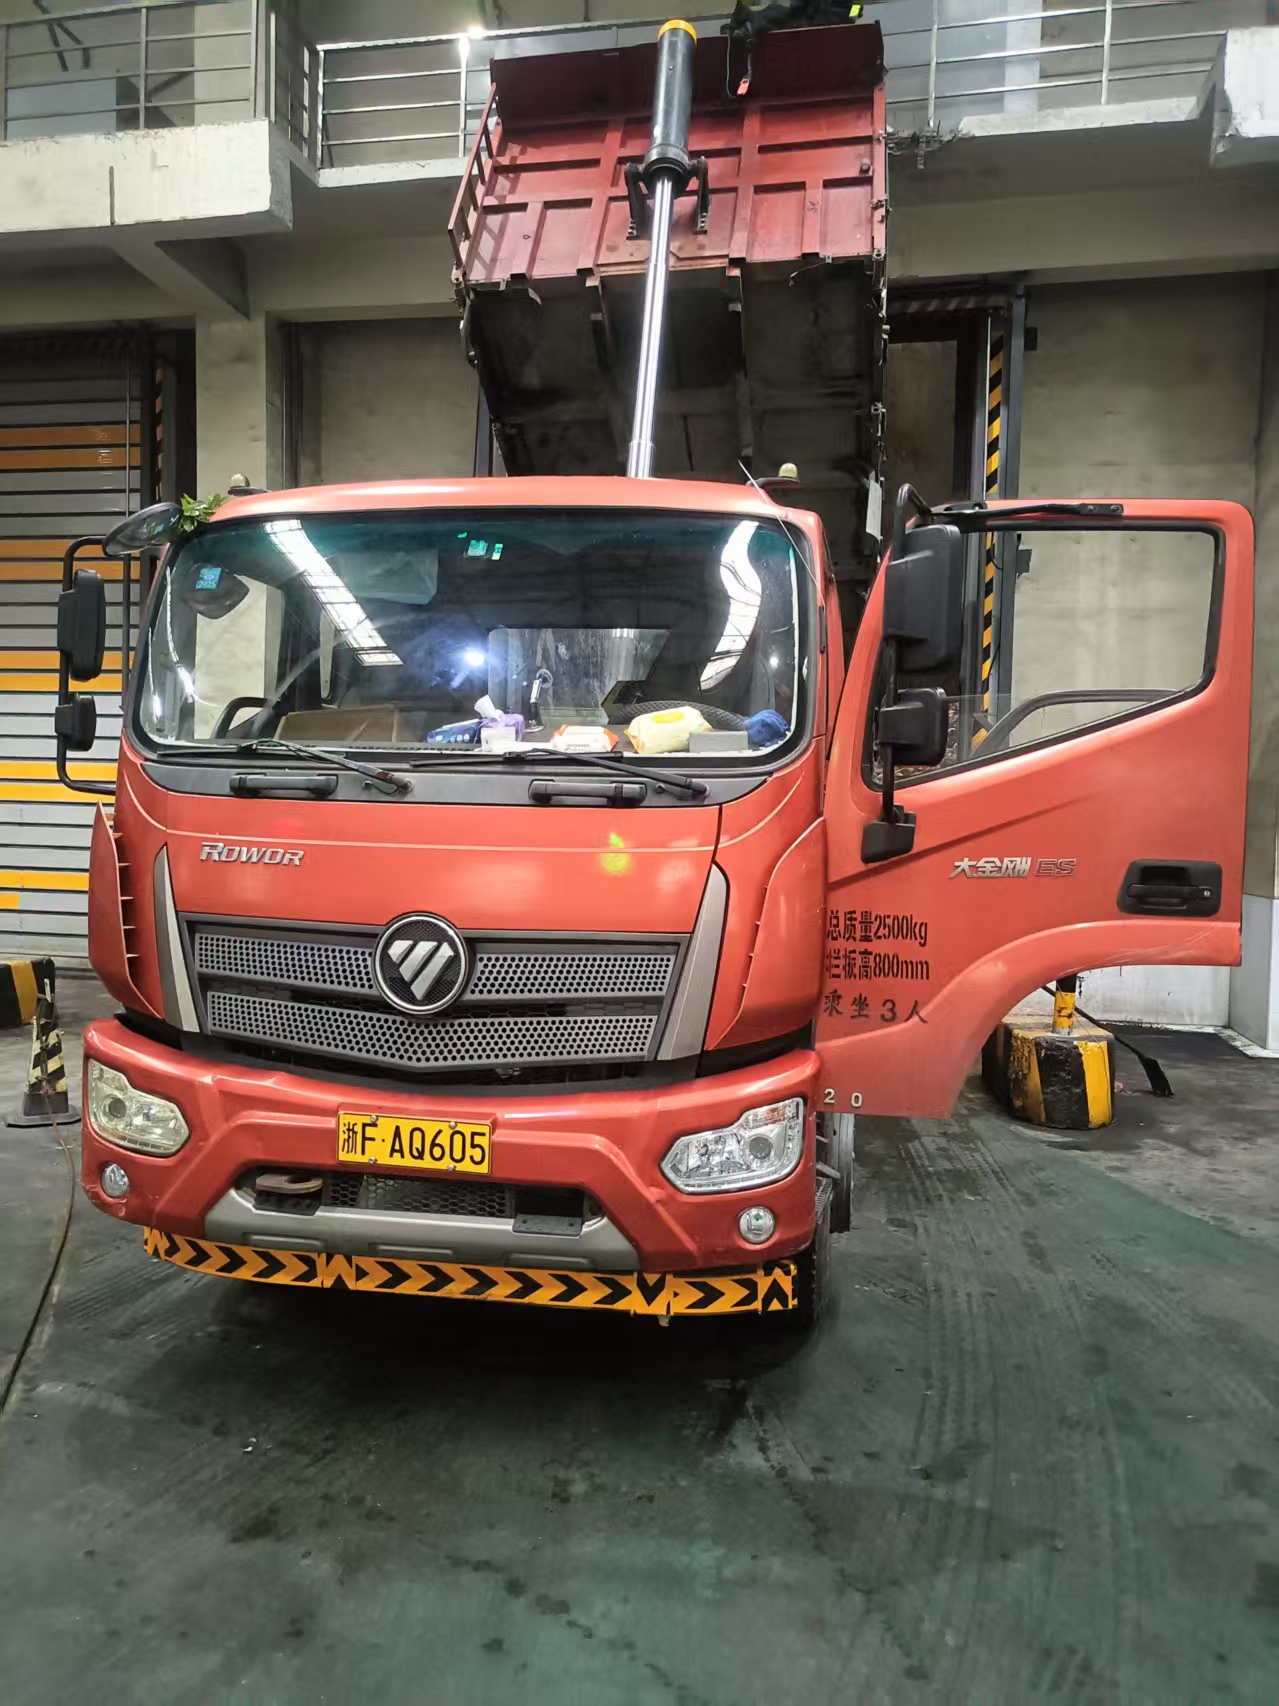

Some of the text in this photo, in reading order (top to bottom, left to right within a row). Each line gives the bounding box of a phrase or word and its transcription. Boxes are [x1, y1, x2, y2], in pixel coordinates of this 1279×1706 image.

[200, 841, 305, 867] ROWOR
[949, 856, 1077, 879] 大金刚 ES
[826, 909, 928, 948] 总质量2500kg
